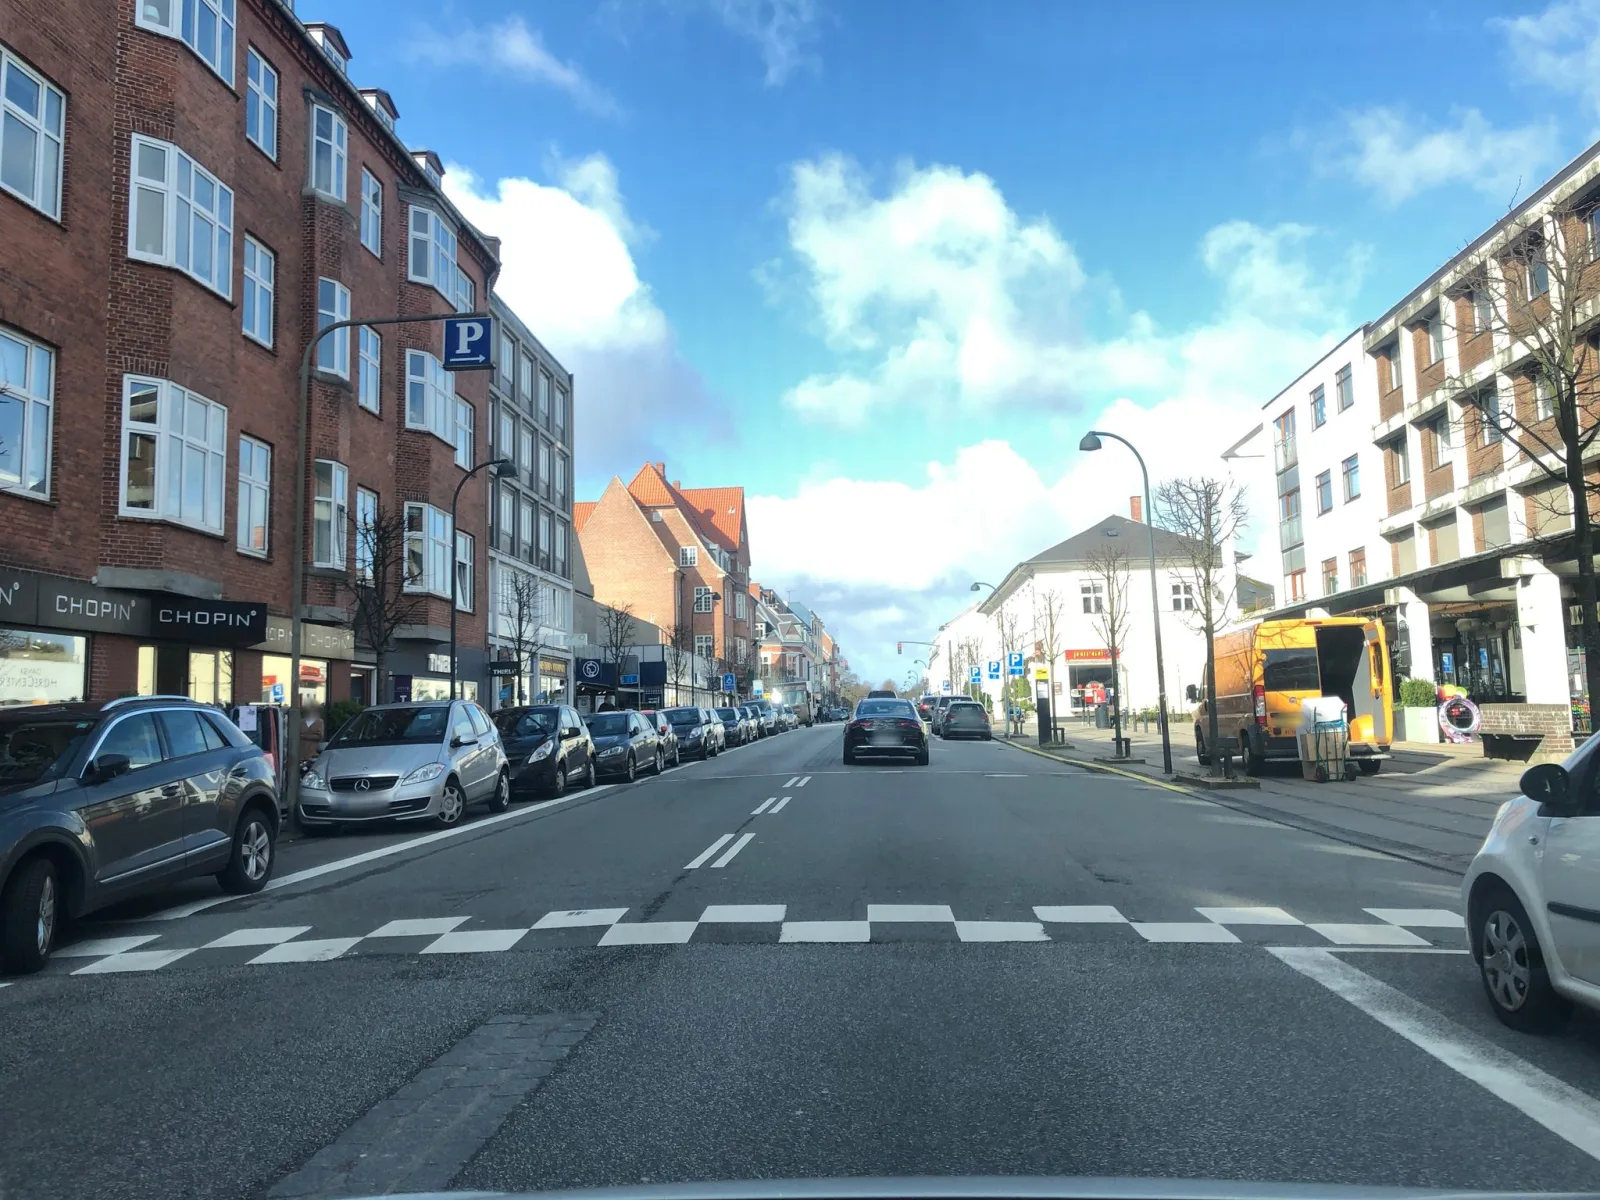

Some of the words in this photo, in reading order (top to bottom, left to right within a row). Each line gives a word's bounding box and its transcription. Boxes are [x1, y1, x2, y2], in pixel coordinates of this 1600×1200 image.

[455, 322, 484, 354] P
[1011, 654, 1021, 666] P
[972, 667, 979, 677] P
[990, 661, 998, 672] P
